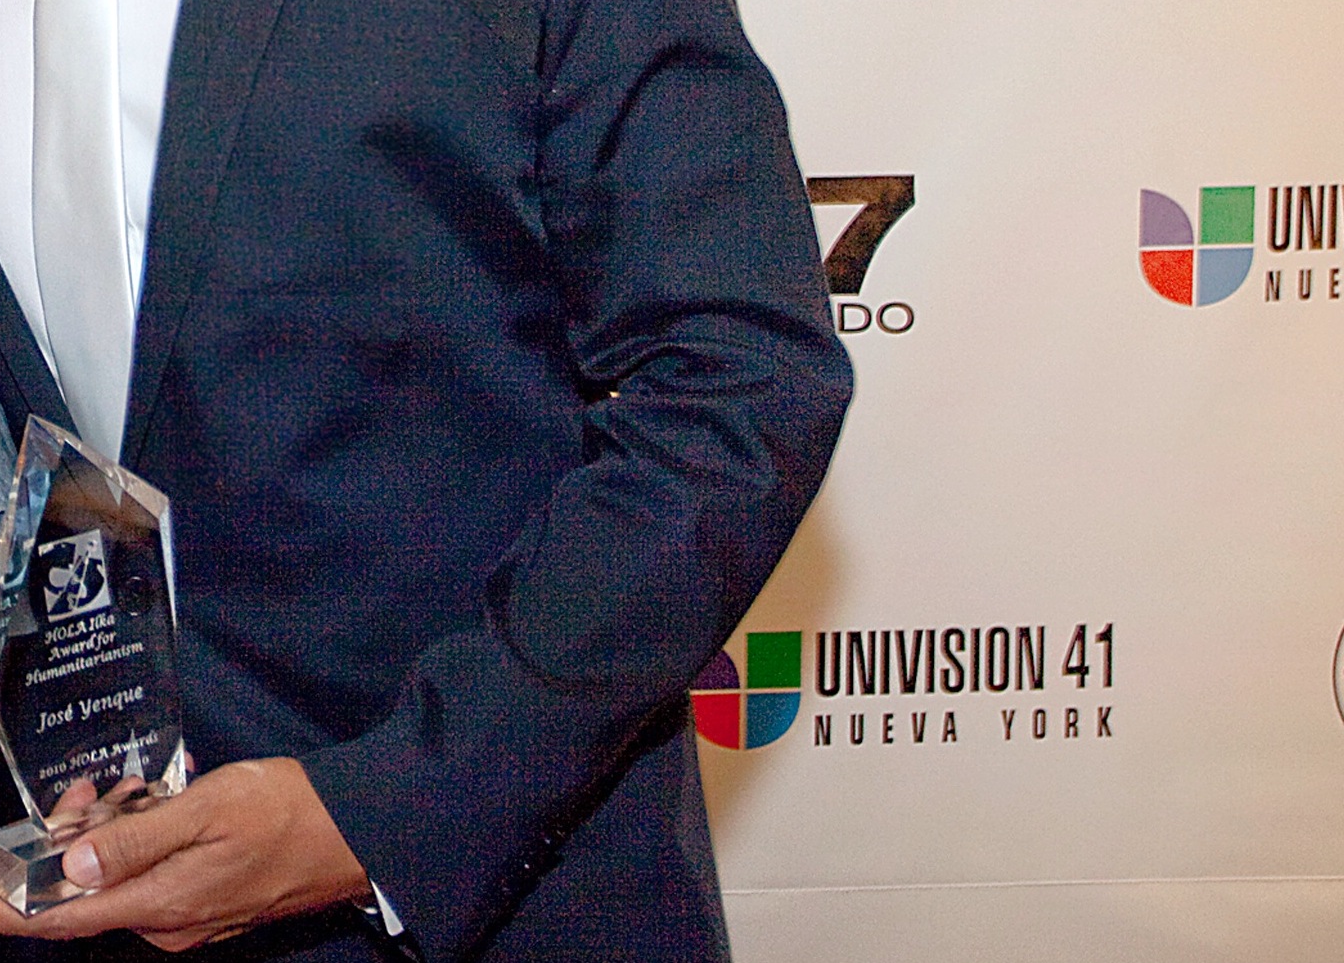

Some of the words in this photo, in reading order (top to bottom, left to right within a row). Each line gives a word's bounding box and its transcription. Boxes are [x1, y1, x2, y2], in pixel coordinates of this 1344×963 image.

[24, 641, 144, 687] Humanitarianism
[48, 633, 96, 662] Award
[814, 626, 1046, 698] UNIVISION
[1060, 622, 1114, 690] 41
[36, 702, 74, 734] José
[78, 686, 144, 721] Yenque
[813, 711, 958, 747] NUEVA
[1001, 706, 1114, 742] YORK
